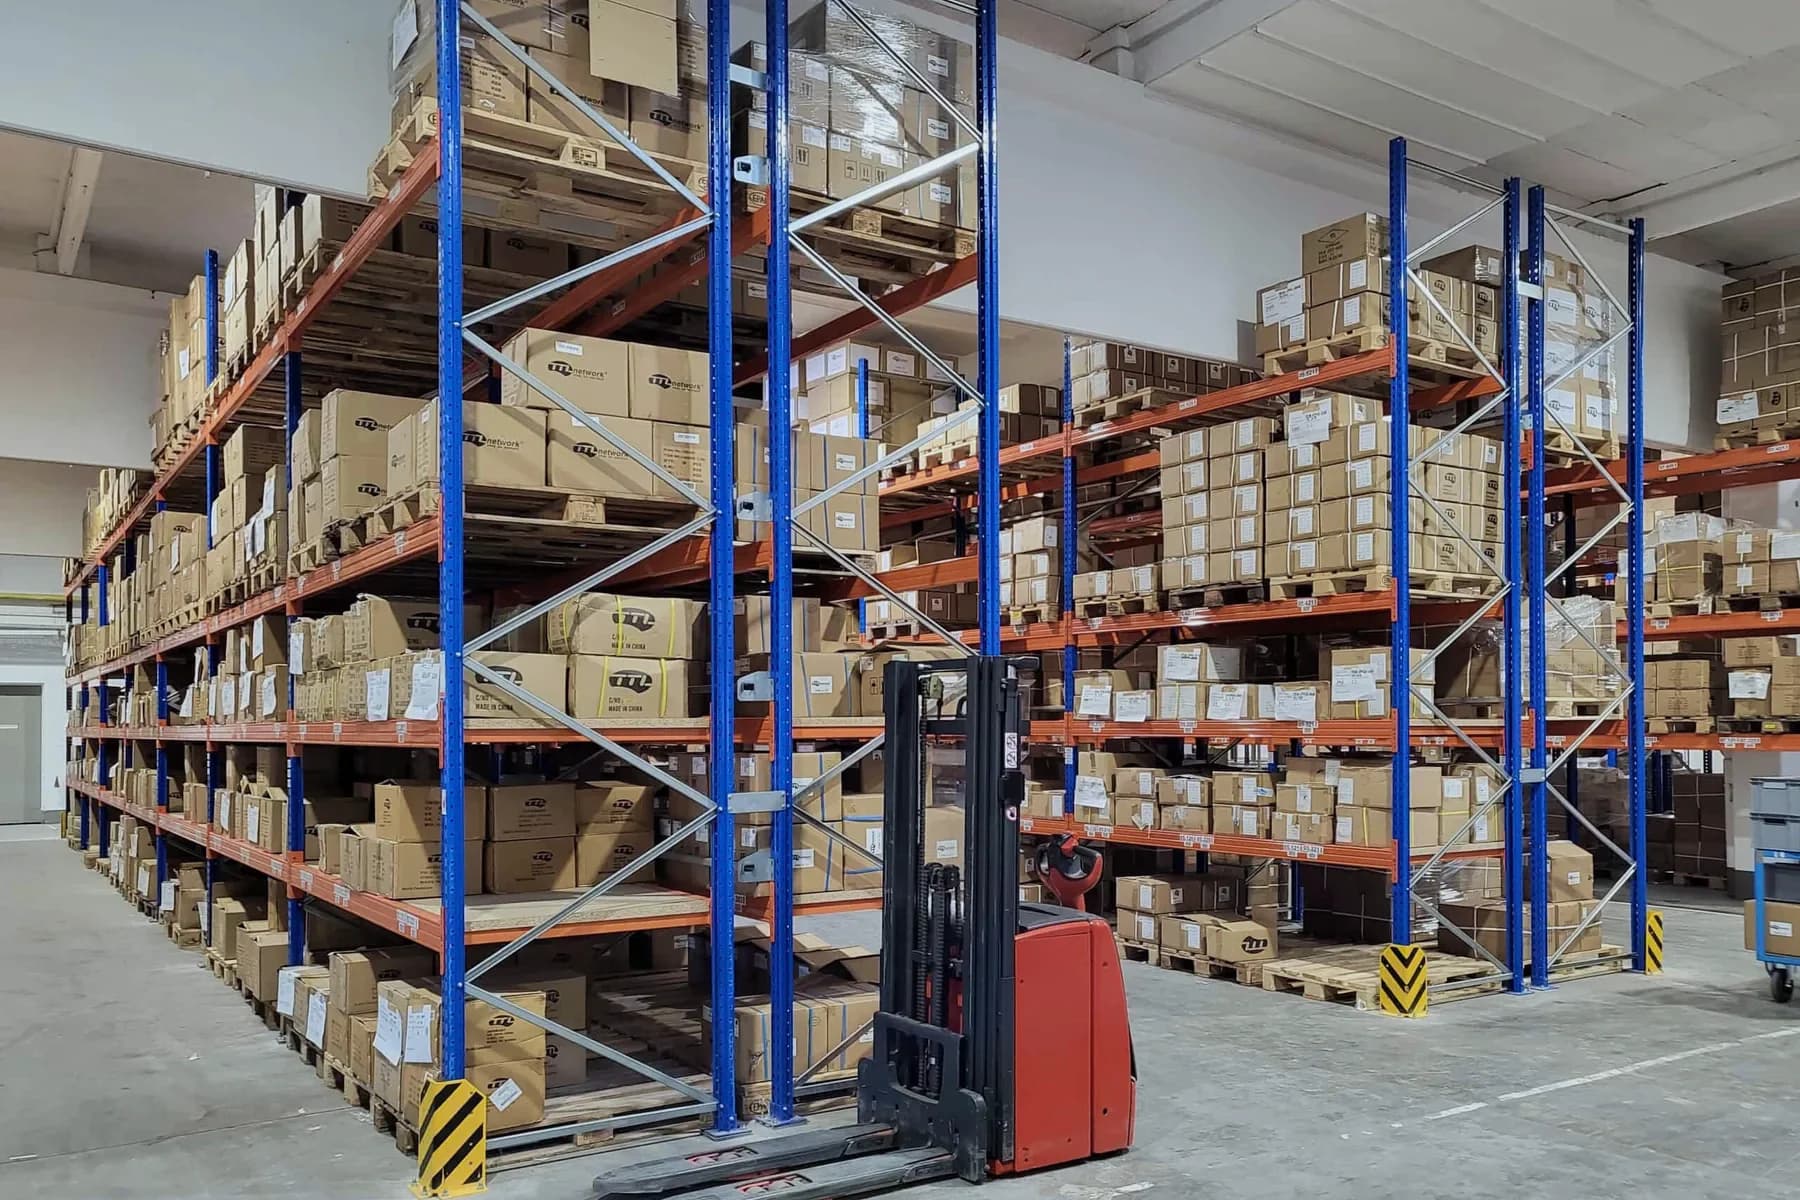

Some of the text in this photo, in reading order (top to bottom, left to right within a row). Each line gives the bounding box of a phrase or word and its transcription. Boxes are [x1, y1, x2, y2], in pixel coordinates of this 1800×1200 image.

[574, 367, 604, 379] network
[487, 438, 519, 448] network
[609, 670, 653, 694] TTL
